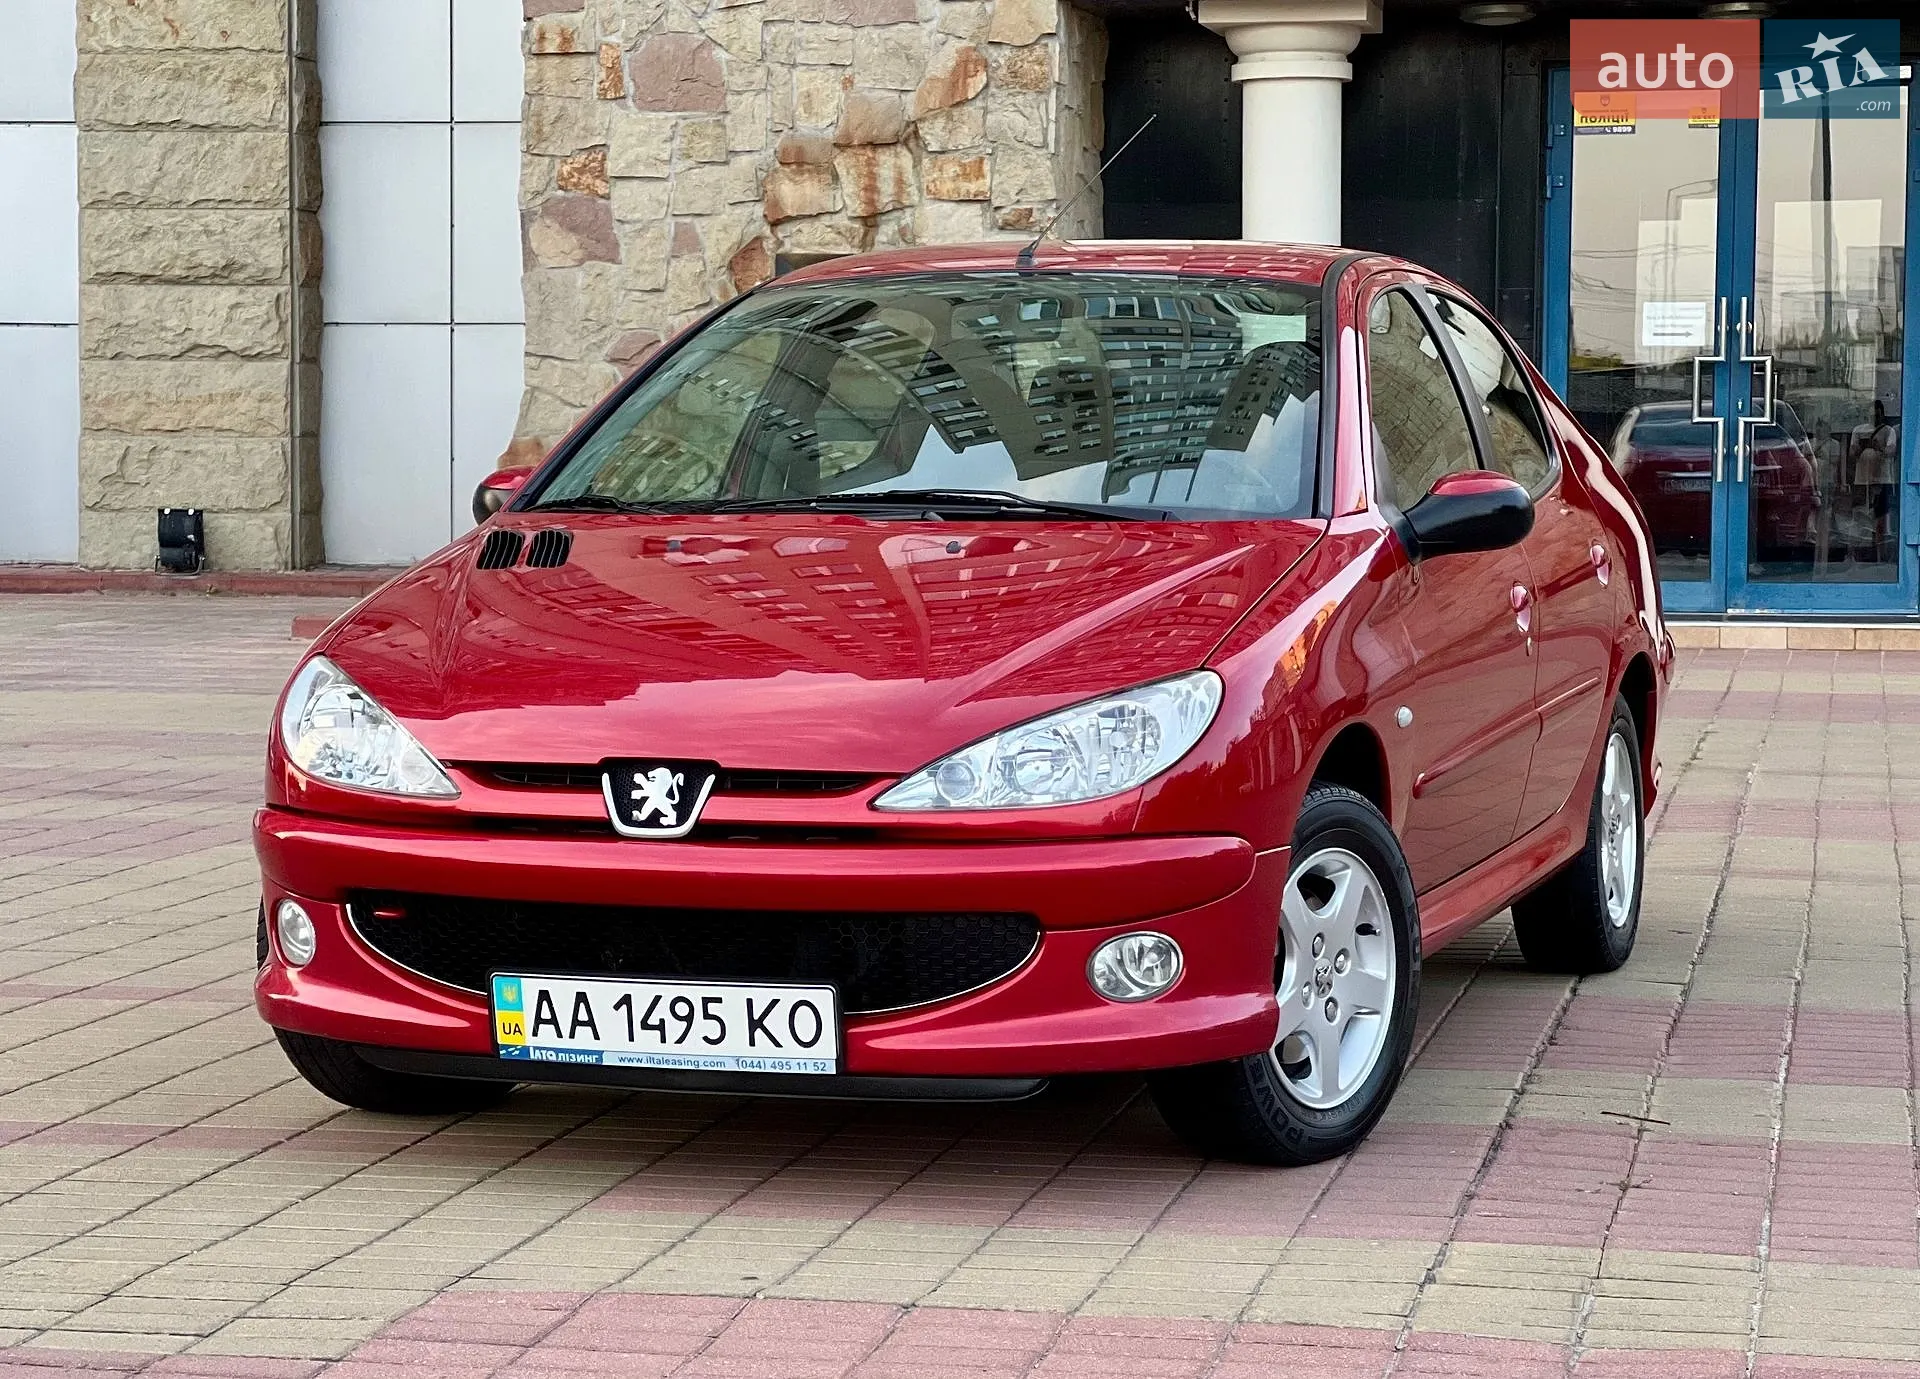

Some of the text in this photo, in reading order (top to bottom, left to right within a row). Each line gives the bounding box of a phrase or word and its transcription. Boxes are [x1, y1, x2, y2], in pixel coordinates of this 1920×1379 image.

[531, 989, 823, 1048] AA 1495 KO
[502, 1022, 523, 1036] UA
[618, 1055, 827, 1072] www.iltaleasing.com (044) 495 11 52
